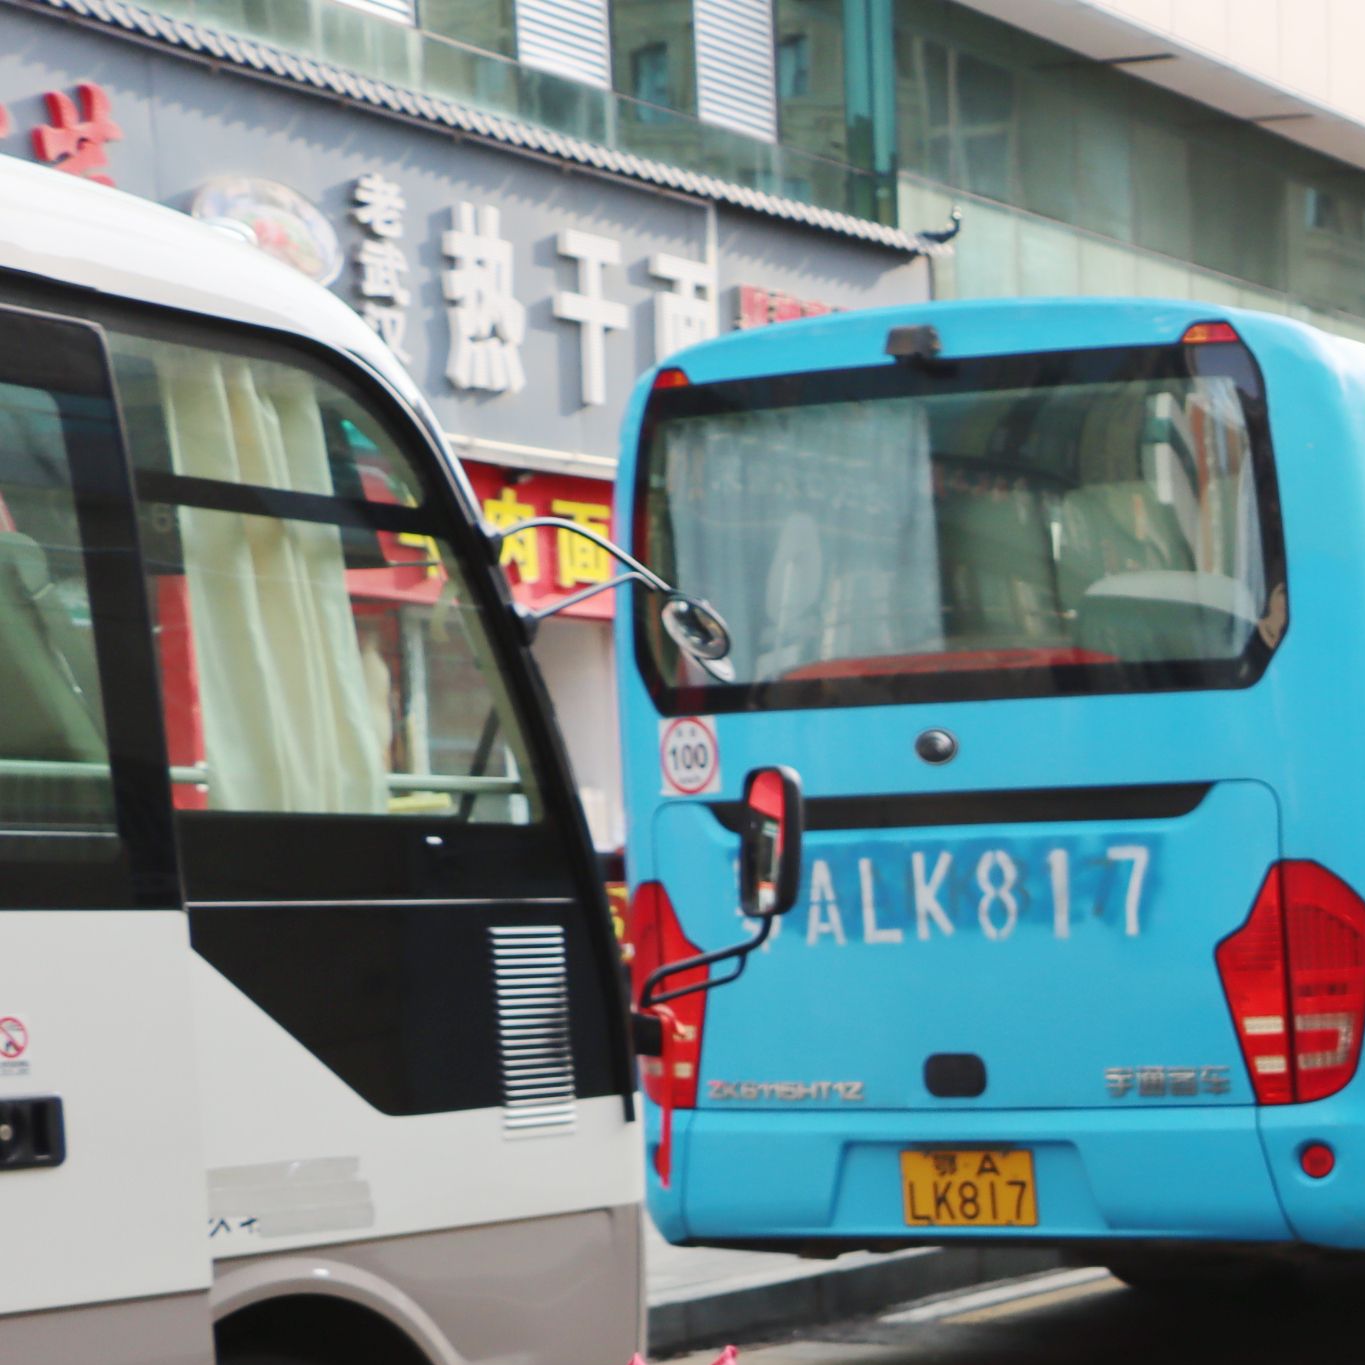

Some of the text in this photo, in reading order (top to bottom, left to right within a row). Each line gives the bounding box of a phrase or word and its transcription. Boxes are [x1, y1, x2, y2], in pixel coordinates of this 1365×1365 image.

[440, 201, 716, 406] 热干面
[670, 743, 708, 770] 100
[733, 845, 1150, 952] ALK817
[908, 1180, 1026, 1220] LK817
